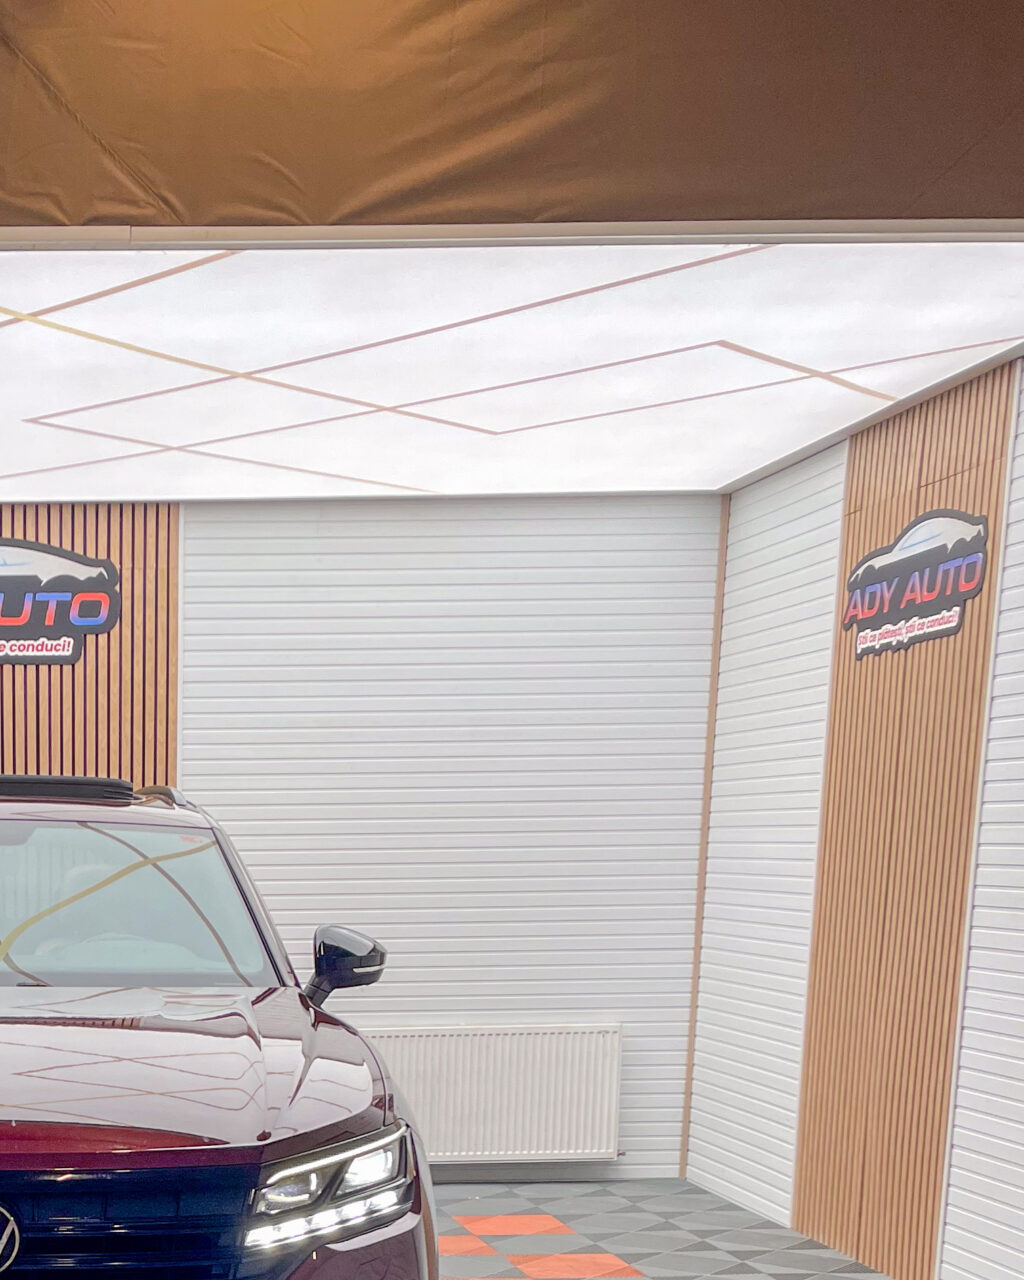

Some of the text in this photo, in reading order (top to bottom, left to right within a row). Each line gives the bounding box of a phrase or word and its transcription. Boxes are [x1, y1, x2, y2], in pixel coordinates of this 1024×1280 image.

[844, 552, 983, 624] ADY AUTO
[9, 641, 71, 653] conduci!
